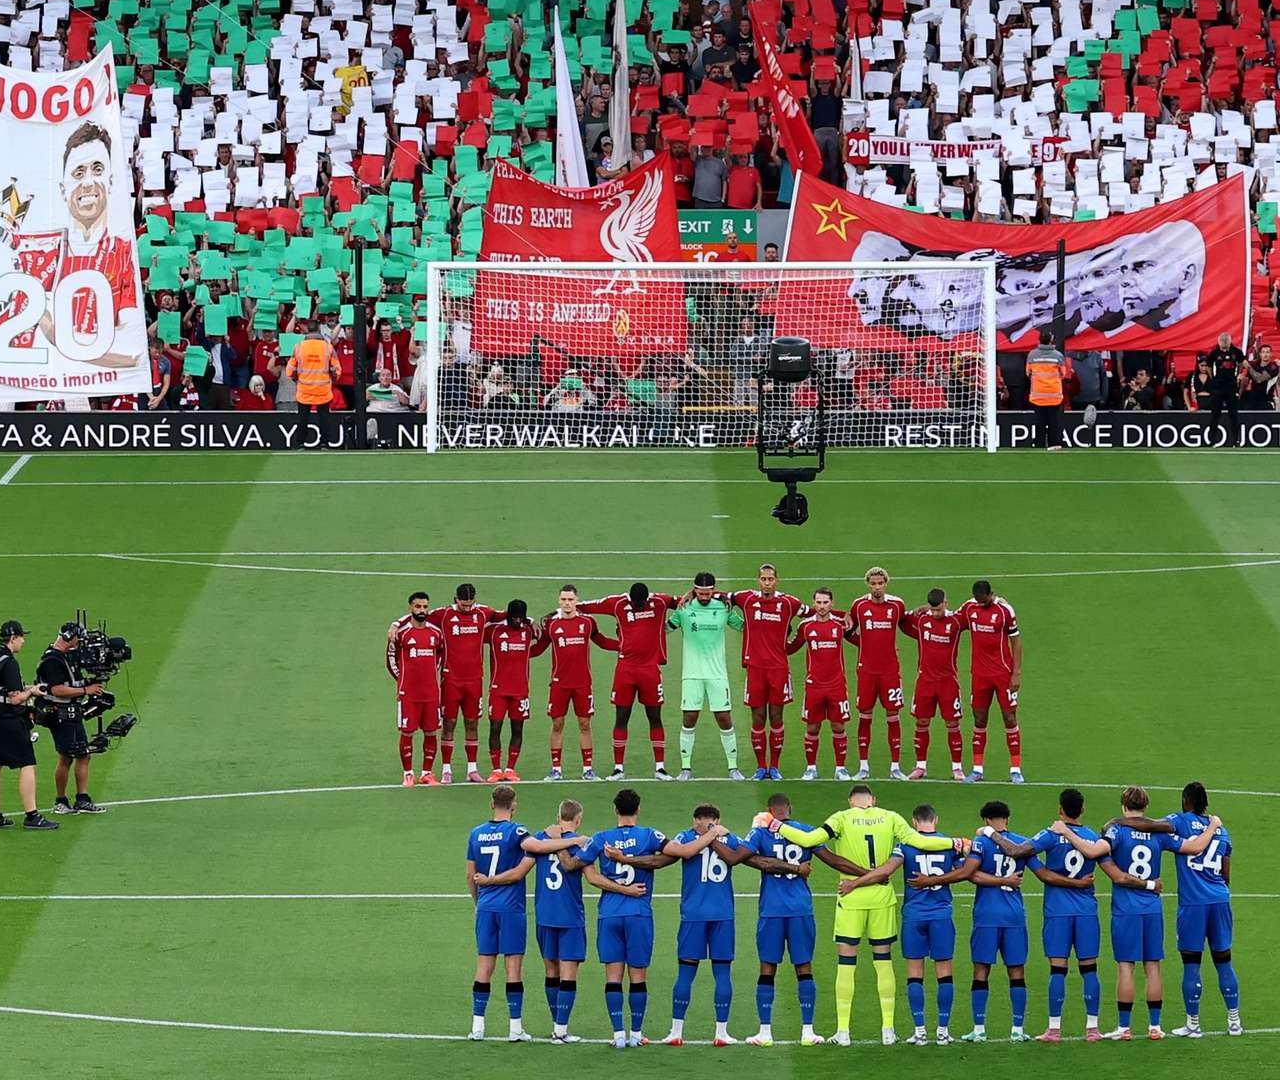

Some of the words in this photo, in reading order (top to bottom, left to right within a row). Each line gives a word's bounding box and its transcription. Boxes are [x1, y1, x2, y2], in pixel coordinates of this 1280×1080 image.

[848, 138, 869, 157] 20
[493, 204, 523, 225] THIS
[530, 208, 573, 228] EARTH
[678, 221, 711, 233] EXIT
[486, 299, 519, 321] THIS
[528, 303, 544, 322] IS
[552, 302, 611, 323] ANFIELD
[31, 424, 53, 448] &
[60, 419, 170, 448] ANDRÉ
[180, 424, 270, 448] SILVA.
[398, 424, 503, 448] NEVER
[513, 425, 606, 448] WALK
[886, 424, 962, 448] REST
[1123, 424, 1227, 448] DIOGO
[657, 684, 664, 695] 5
[888, 687, 903, 701] 22
[519, 698, 530, 712] 30
[588, 695, 594, 710] 7
[839, 700, 850, 713] 10
[953, 697, 961, 710] 6
[1130, 831, 1151, 841] SCOTT
[480, 846, 501, 877] 7
[864, 834, 877, 868] 1
[1128, 845, 1152, 881] 8
[1187, 835, 1223, 875] 24
[545, 853, 563, 890] 3
[700, 846, 728, 883] 16
[915, 854, 945, 891] 15
[993, 854, 1017, 891] 12
[1064, 849, 1085, 879] 9
